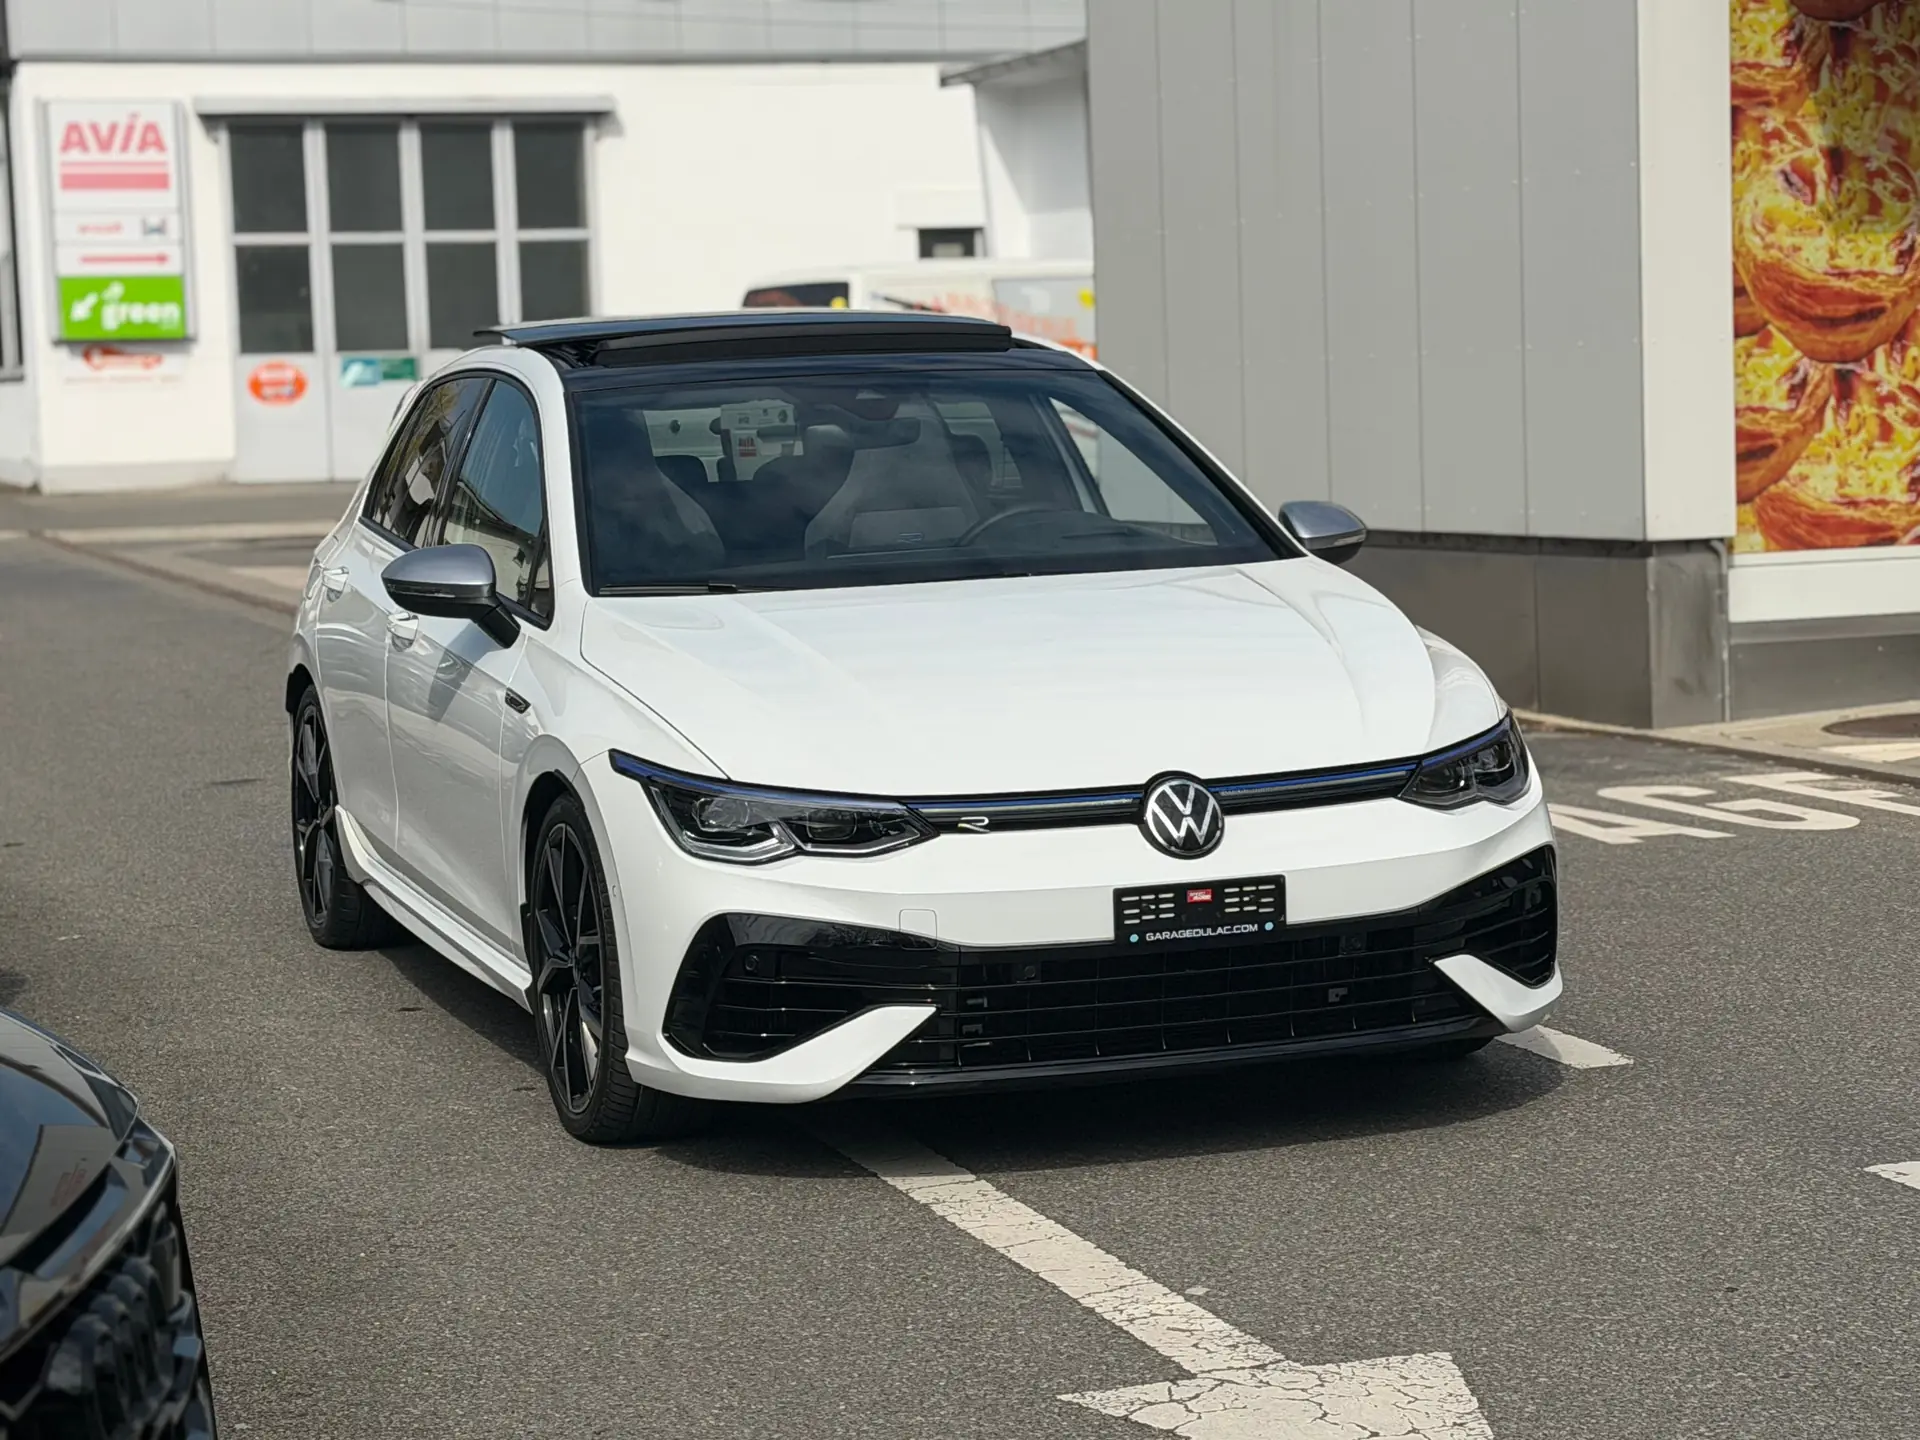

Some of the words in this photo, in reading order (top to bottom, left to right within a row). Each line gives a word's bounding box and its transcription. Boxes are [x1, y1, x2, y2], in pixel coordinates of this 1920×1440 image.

[60, 112, 167, 153] AVIA
[101, 300, 181, 332] green
[1145, 923, 1259, 942] GARAGEDULAC.COM
